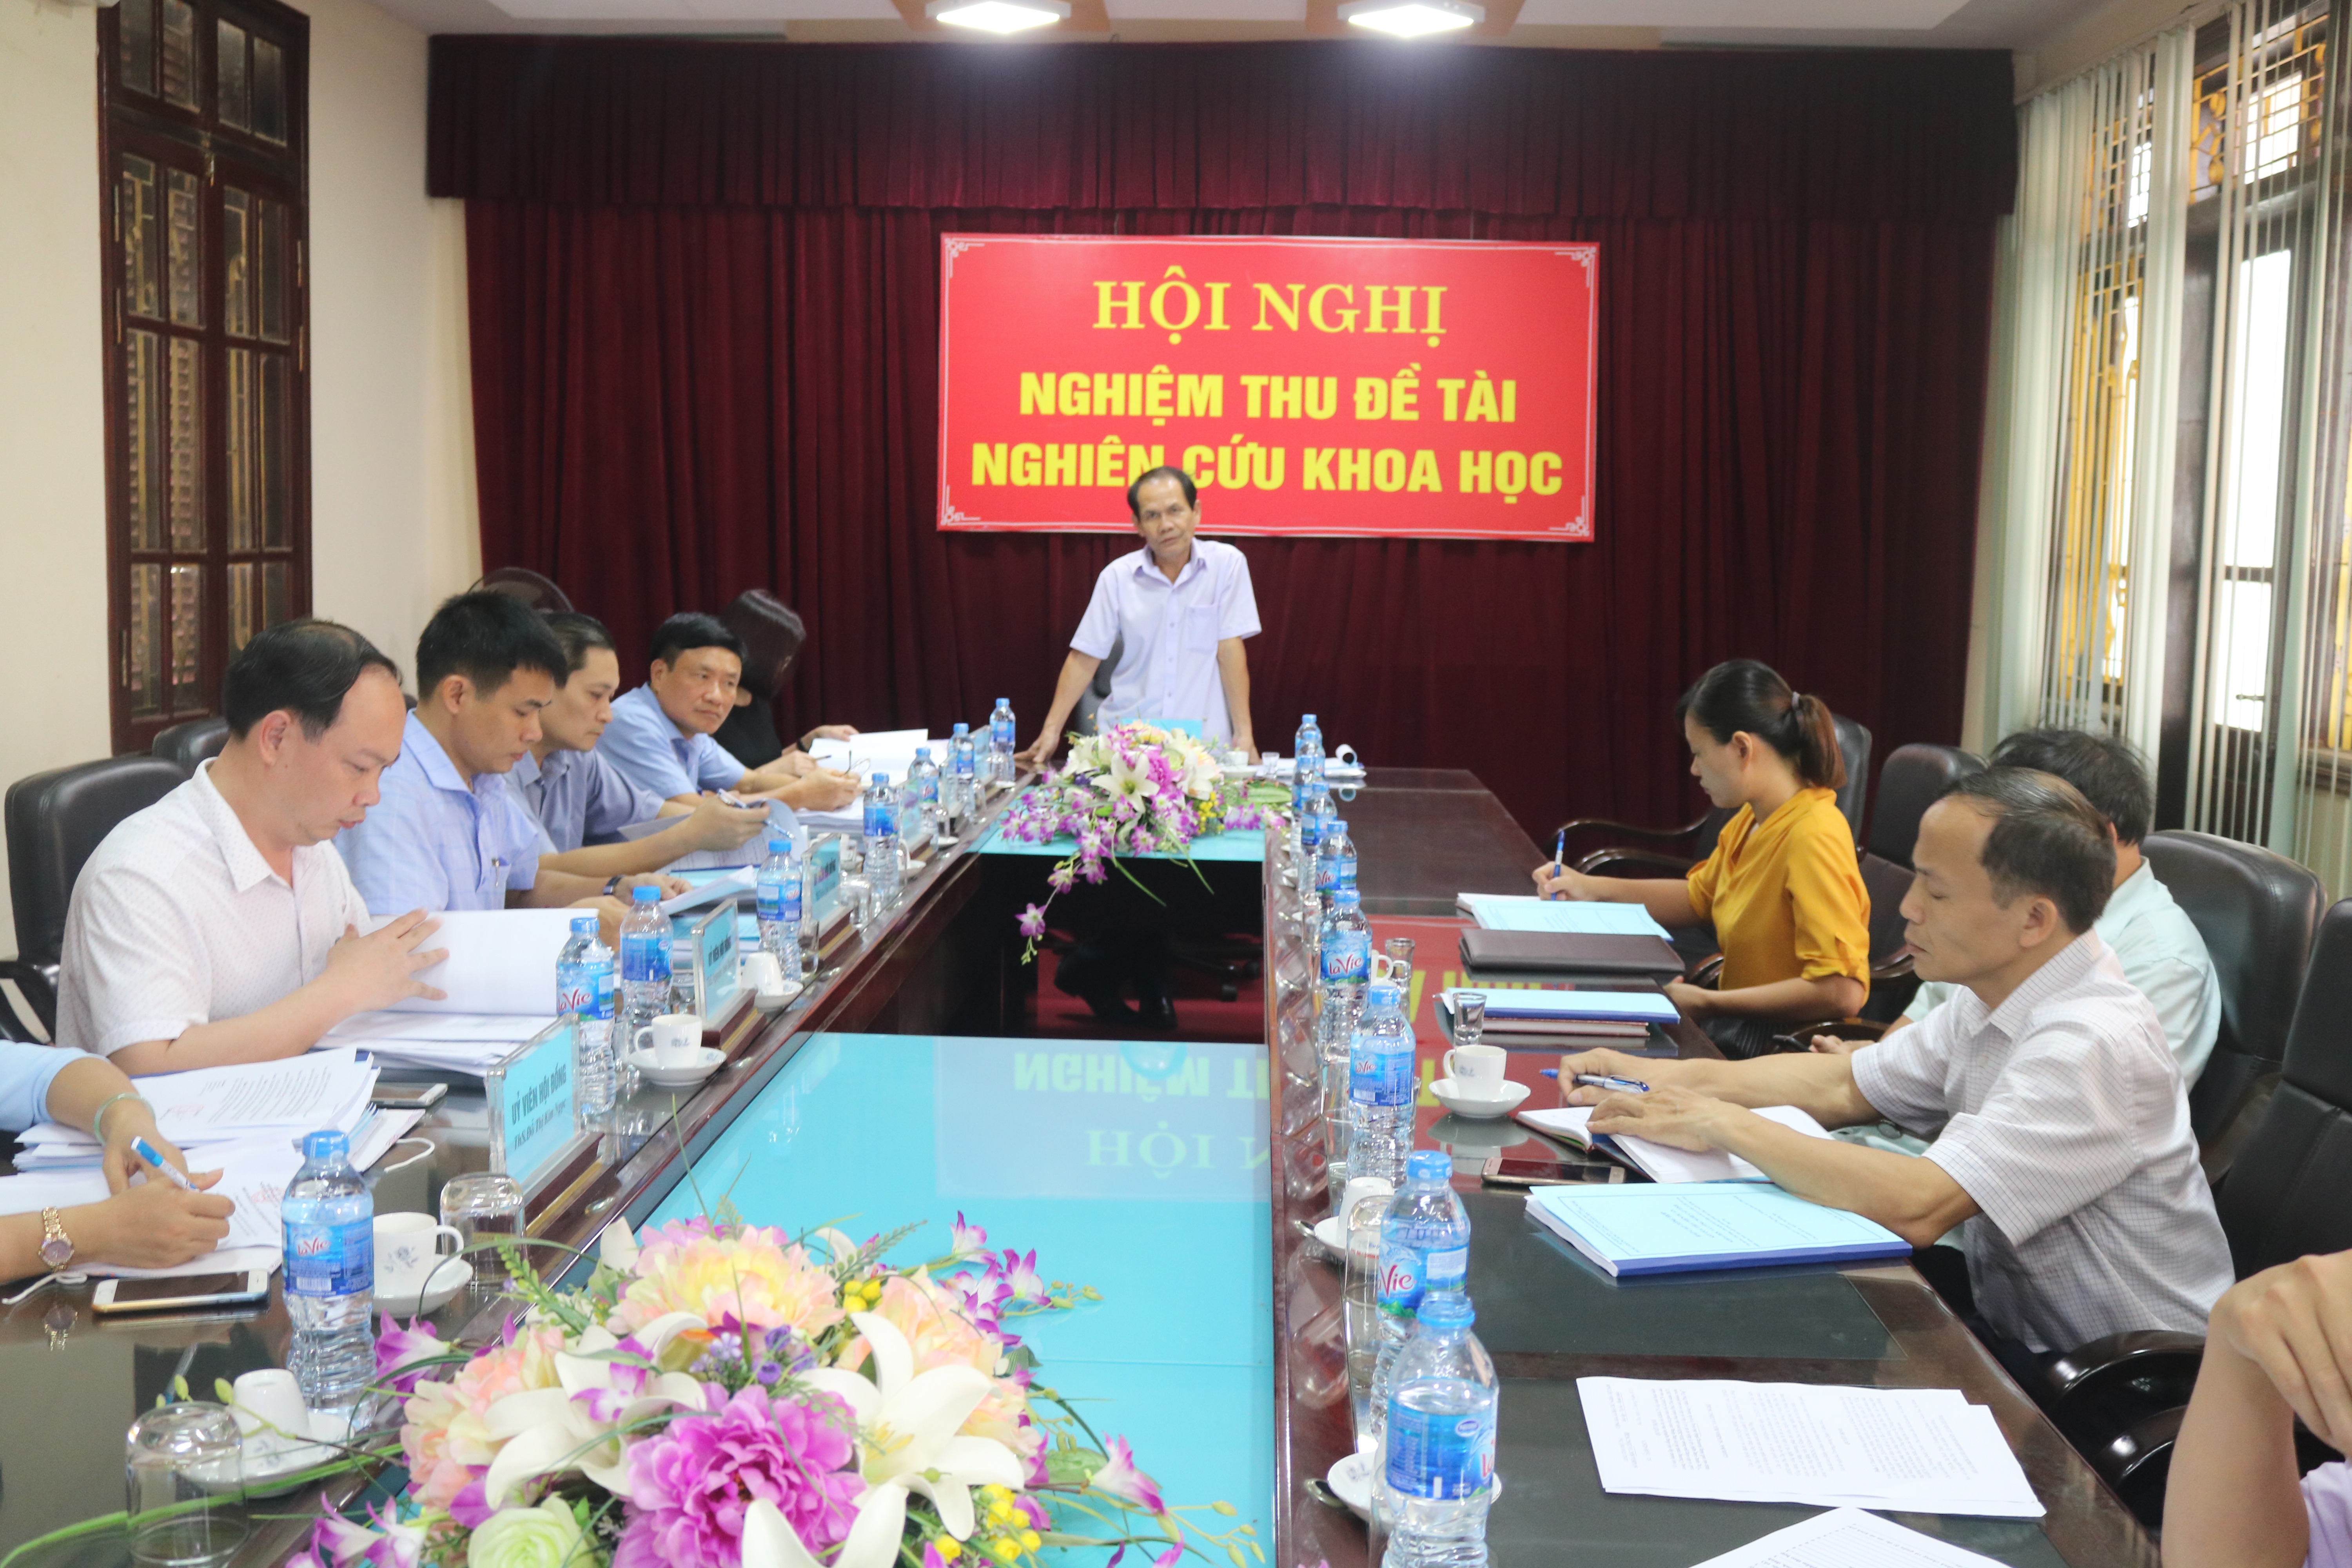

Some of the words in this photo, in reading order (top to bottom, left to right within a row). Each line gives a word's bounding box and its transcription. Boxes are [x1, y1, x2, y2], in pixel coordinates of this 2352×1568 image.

[1092, 265, 1232, 346] HỘI
[1251, 282, 1448, 348] NGHỊ
[1019, 364, 1224, 427] NGHIỆM
[1240, 375, 1338, 420] THU
[1352, 362, 1420, 423] ĐỀ
[1436, 369, 1517, 423] TÀI
[971, 434, 1165, 487] NGHIÊN
[1182, 433, 1286, 491] CỨU
[1302, 447, 1443, 493] KHOA
[1459, 450, 1563, 504] HỌC
